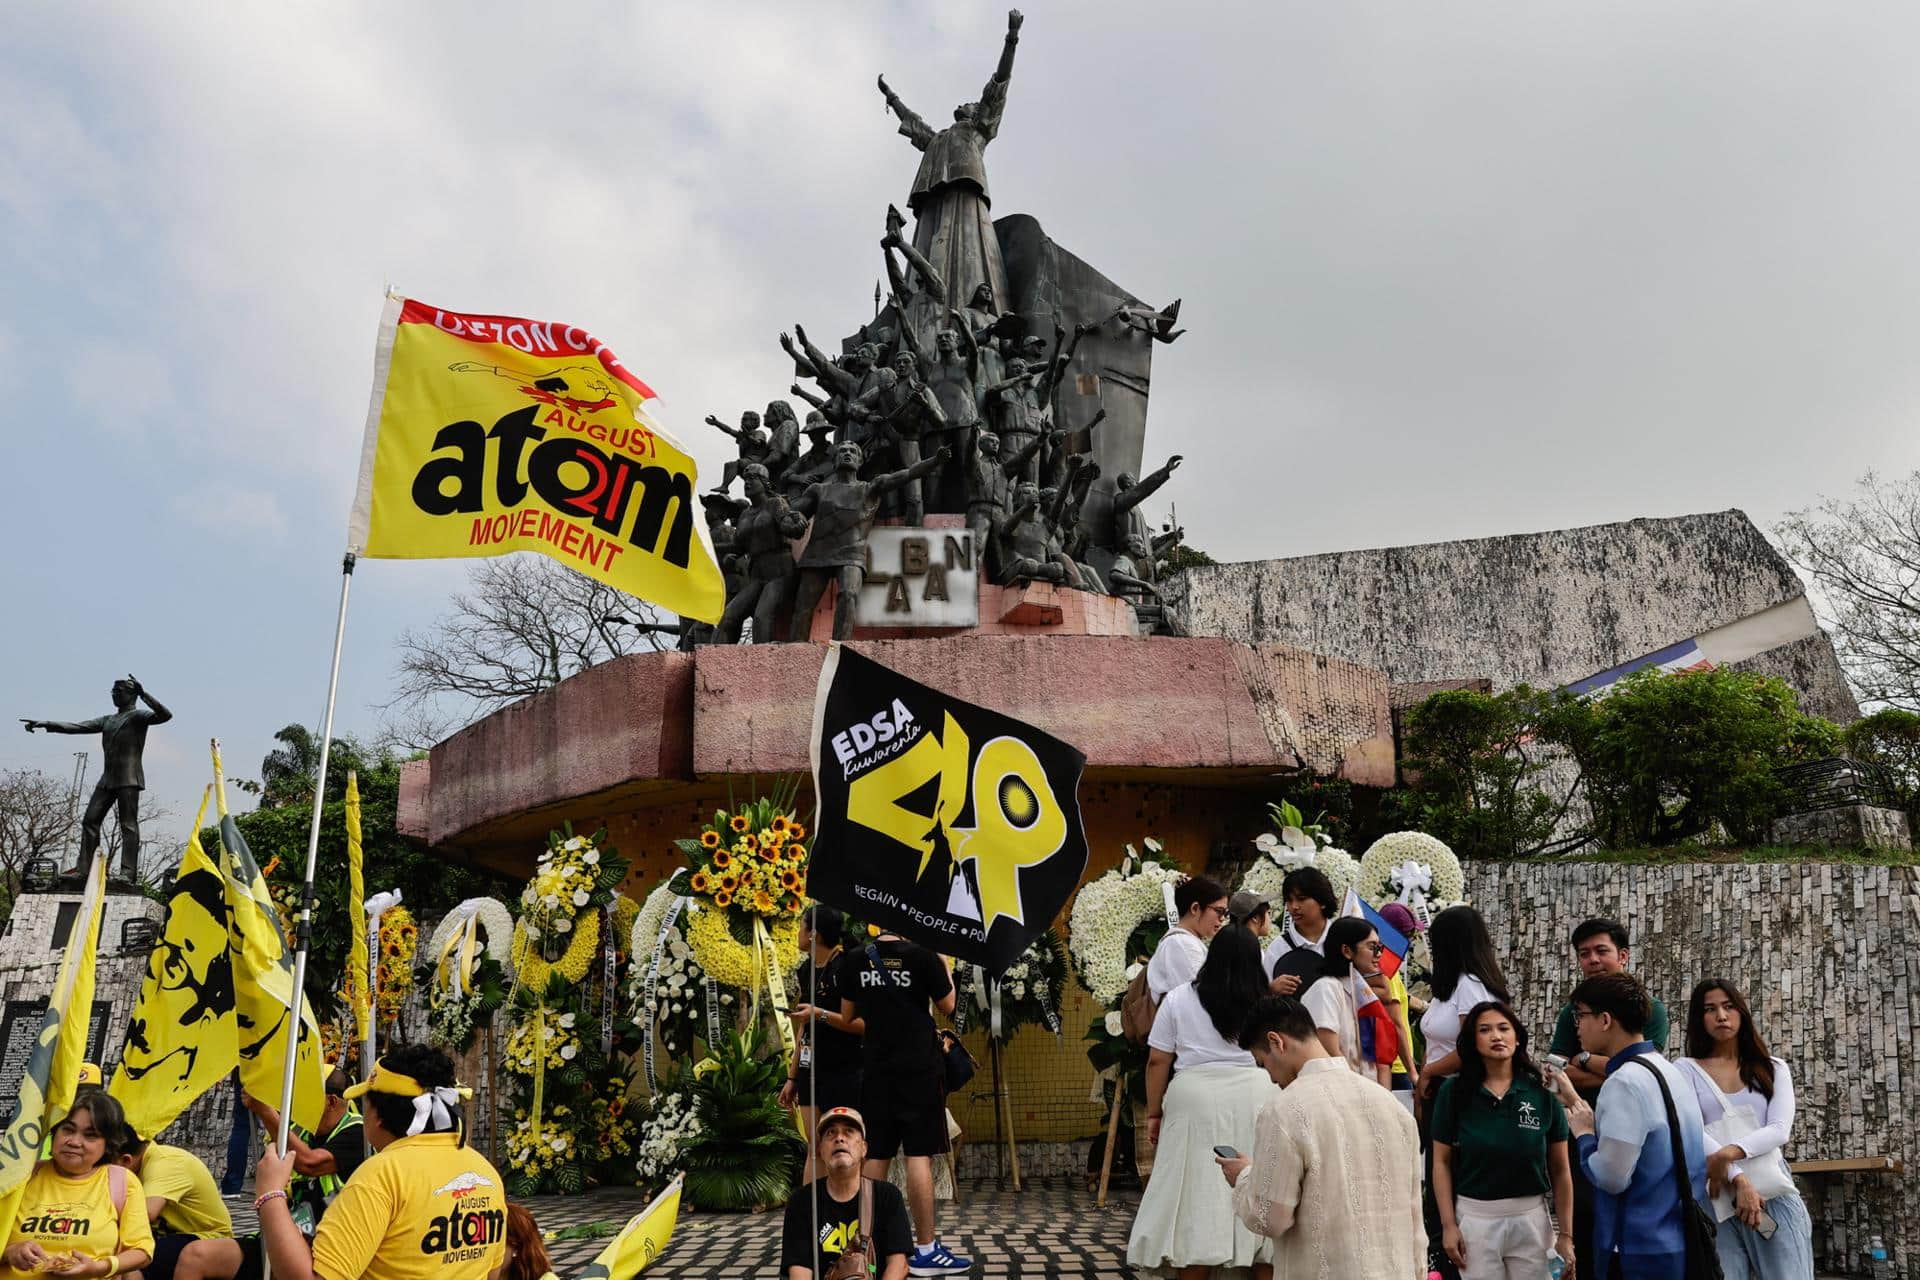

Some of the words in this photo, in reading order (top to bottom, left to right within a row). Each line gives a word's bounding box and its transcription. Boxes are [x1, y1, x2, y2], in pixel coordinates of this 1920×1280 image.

[544, 408, 656, 459] AUGUST
[411, 404, 697, 569] atom
[469, 509, 624, 572] MOVEMENT
[831, 697, 914, 765] EDSA
[855, 884, 899, 908] REGAIN
[908, 907, 959, 934] PEOPLE
[969, 928, 986, 943] PO
[860, 970, 911, 988] PRSS
[21, 1214, 90, 1236] atom
[421, 1201, 504, 1255] atom
[461, 1197, 490, 1209] AUGUST
[442, 1247, 488, 1265] MOVEMENT
